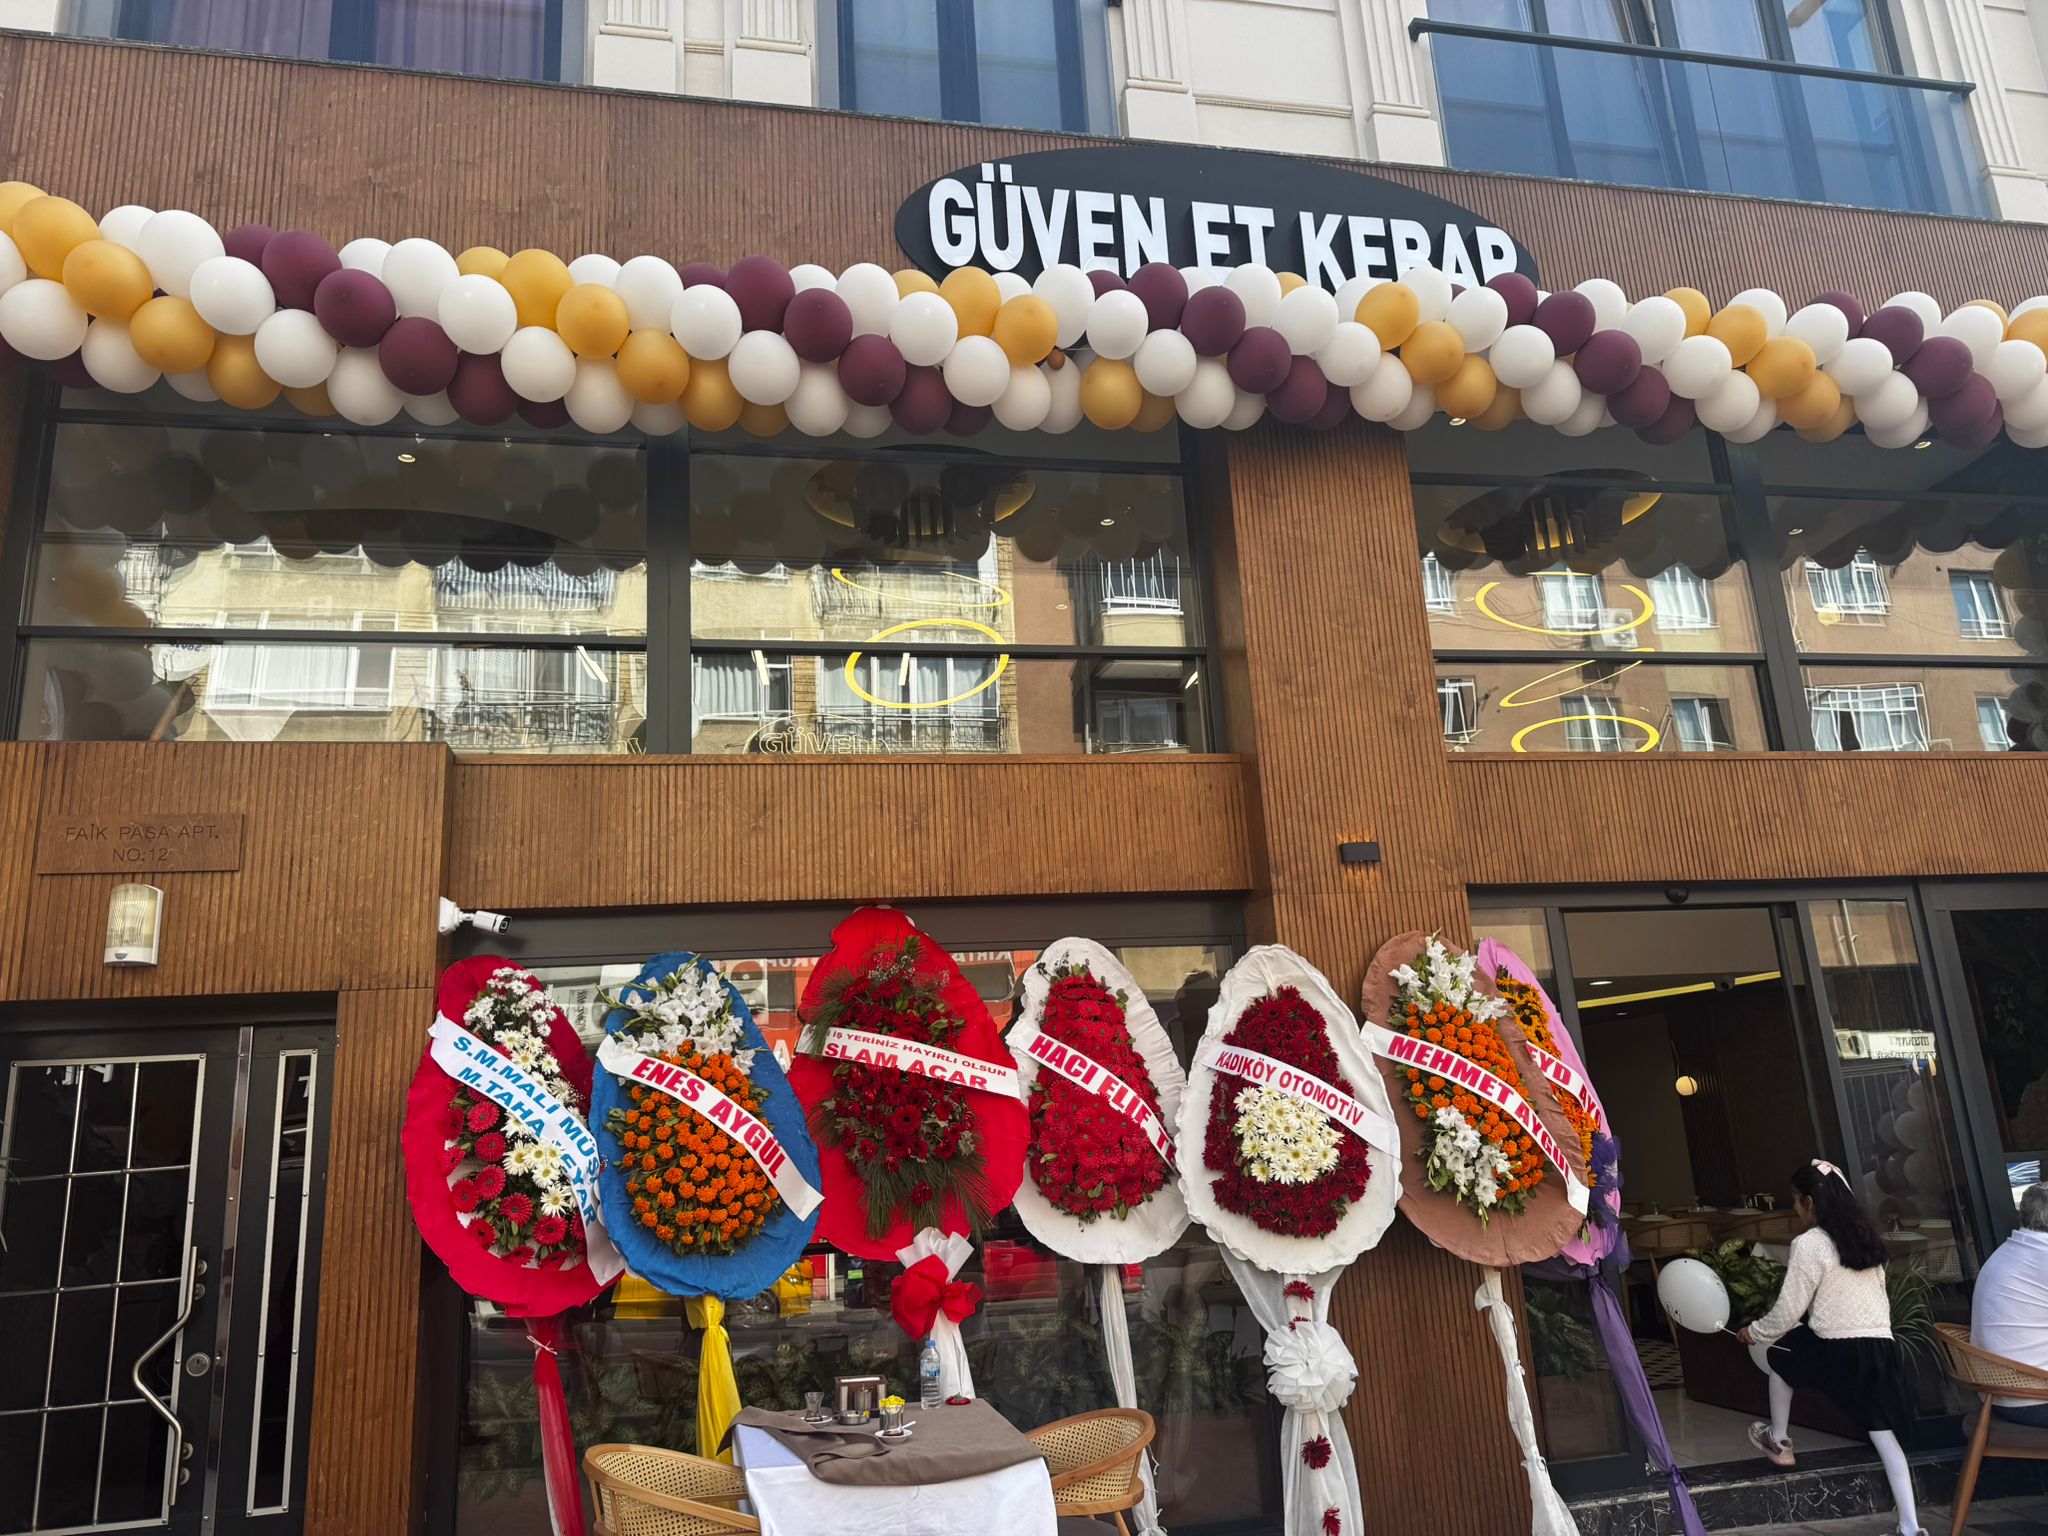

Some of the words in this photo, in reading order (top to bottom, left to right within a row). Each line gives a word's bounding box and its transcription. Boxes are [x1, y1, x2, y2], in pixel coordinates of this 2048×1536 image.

[928, 163, 1169, 278] GÜVEN
[1191, 201, 1275, 286] ET
[1299, 211, 1518, 294] KEBAP
[65, 823, 108, 841] FAİK
[119, 825, 170, 843] PAŞA
[178, 825, 220, 841] APT.
[112, 847, 169, 863] NO:12
[453, 1035, 560, 1113] S.M.MALİ
[824, 1042, 901, 1068] SLAM
[846, 1033, 899, 1050] YERİNİZ
[902, 1044, 960, 1064] HAYIRLI
[961, 1060, 1008, 1077] OLSUN
[1028, 1034, 1099, 1085] HACI
[1388, 1035, 1515, 1106] MEHMET
[1526, 1043, 1572, 1086] EYD
[631, 1057, 705, 1102] ENES
[708, 1098, 788, 1180] AYGÜL
[1214, 1050, 1277, 1083] KADIKÖY
[1278, 1070, 1365, 1126] OTOMOTİV
[457, 1066, 546, 1137] M.TAHA
[552, 1139, 597, 1226] EYAR
